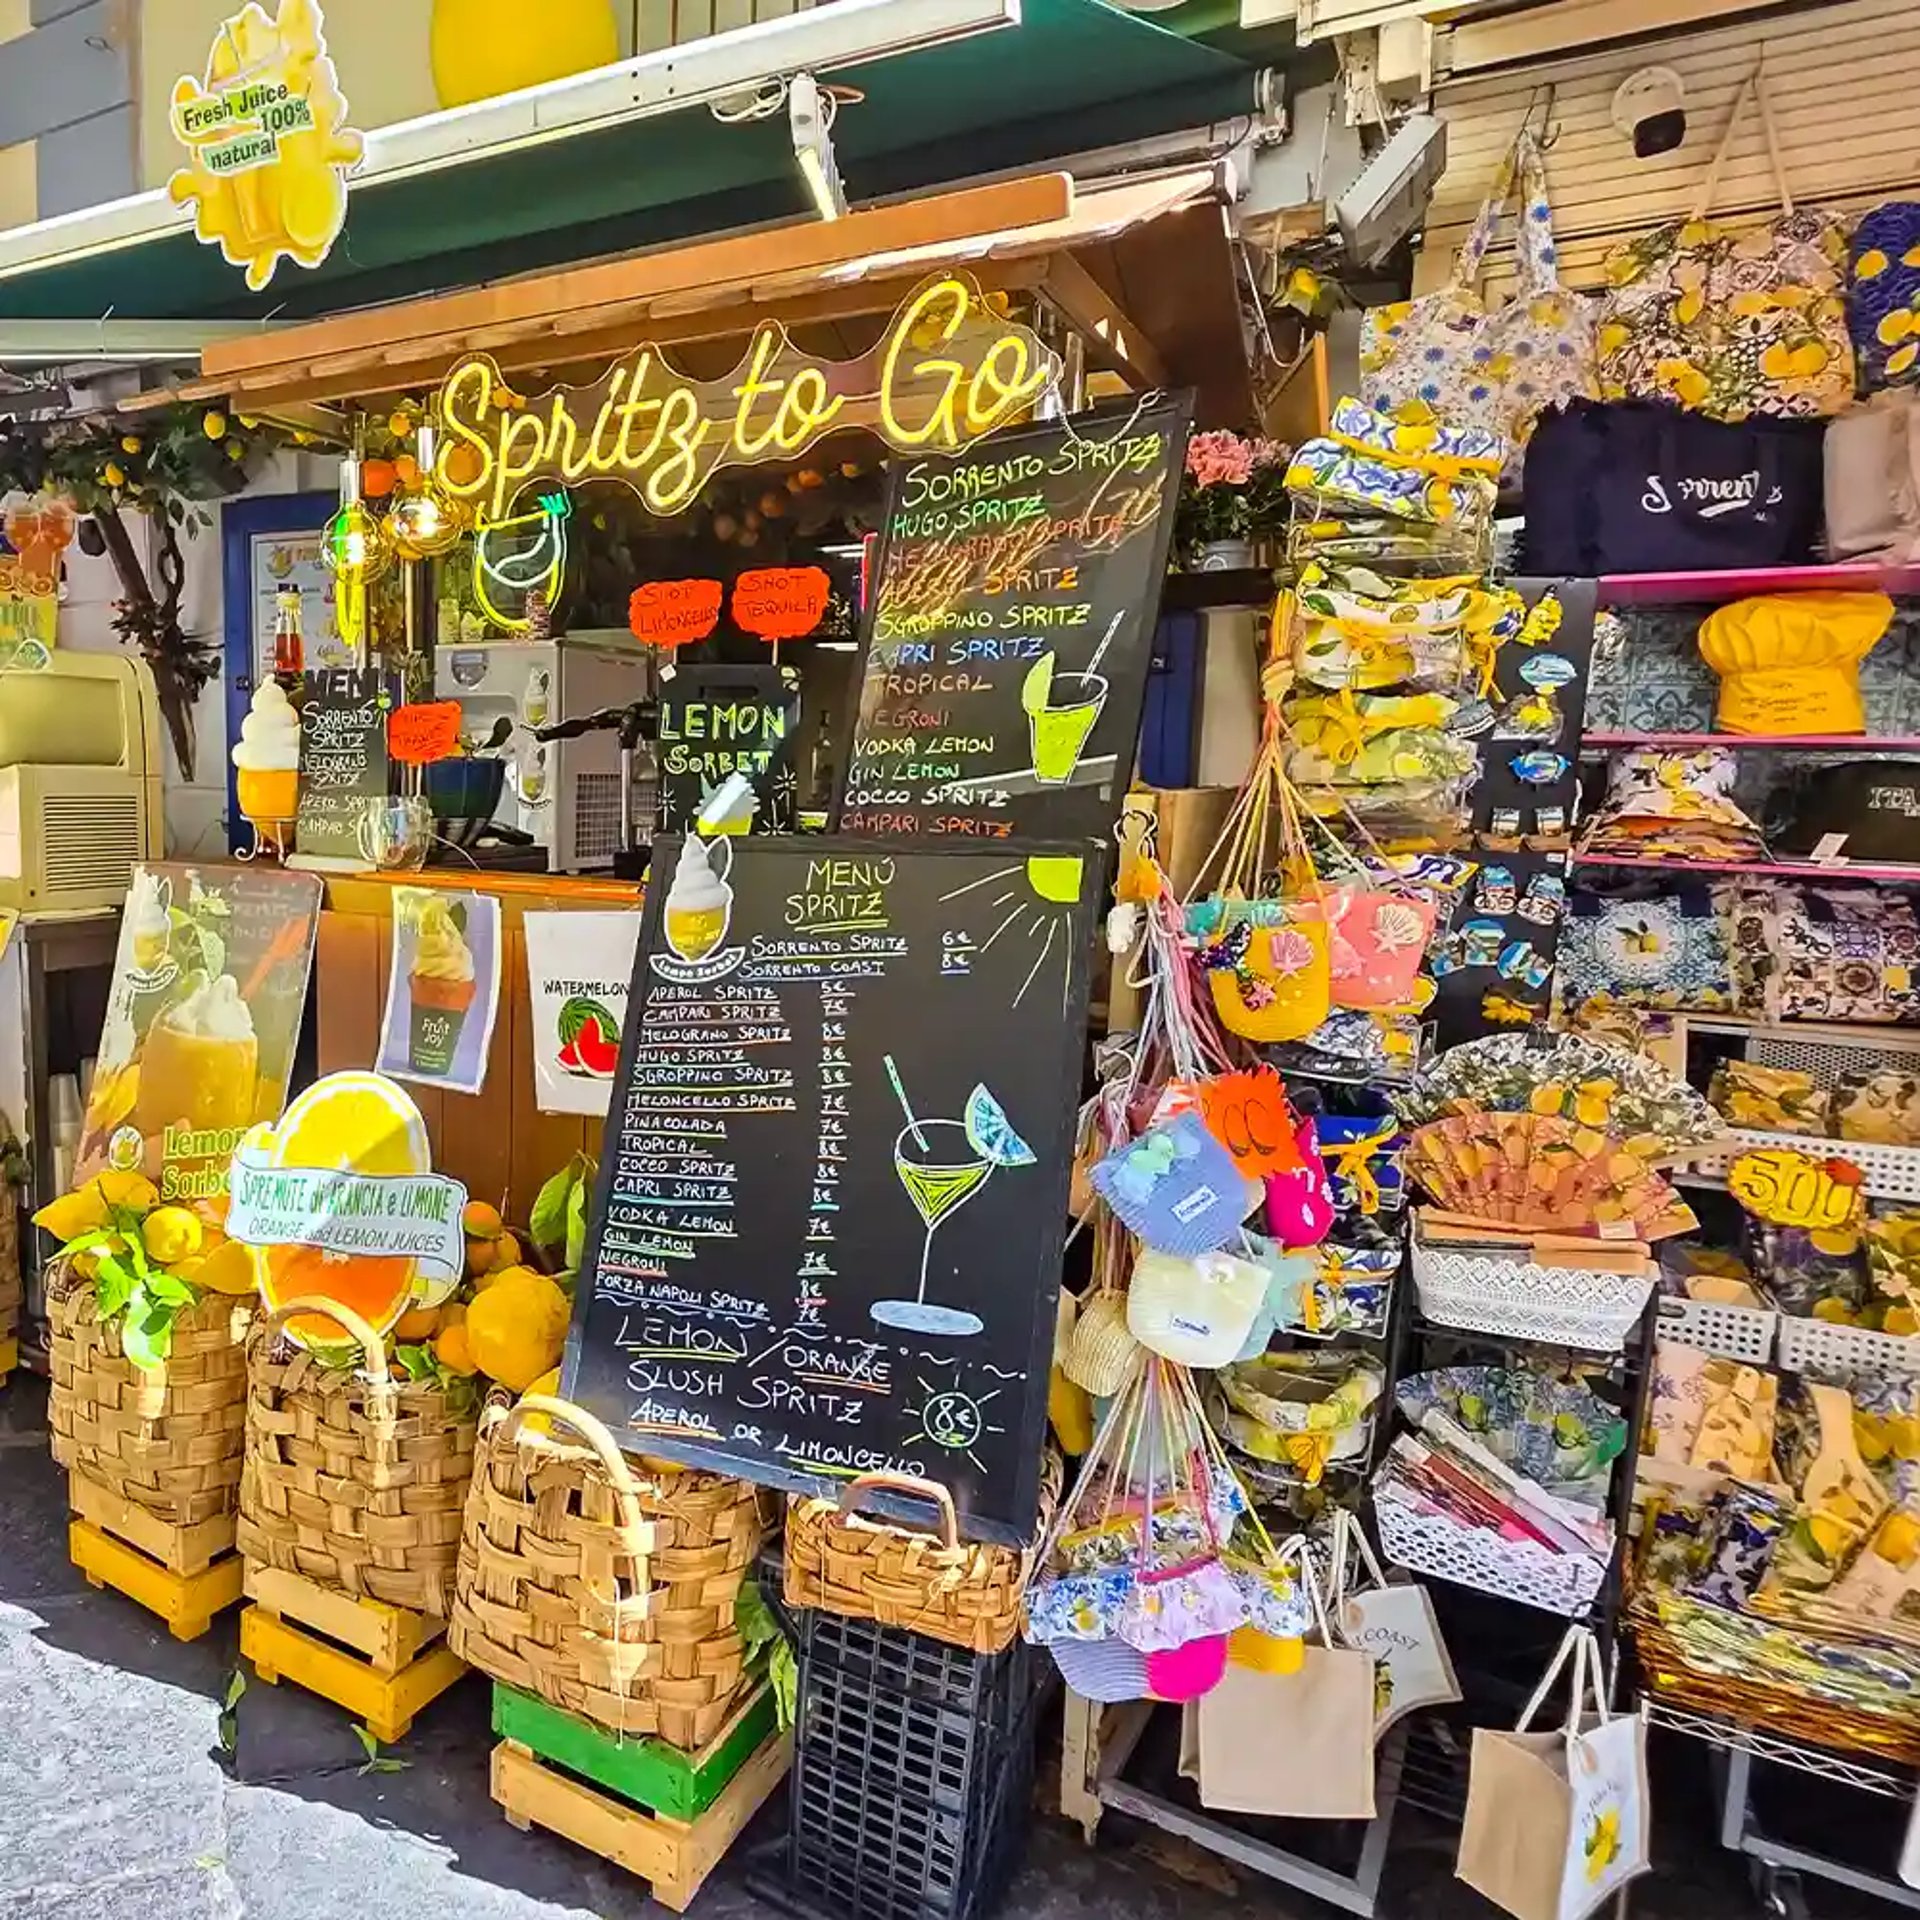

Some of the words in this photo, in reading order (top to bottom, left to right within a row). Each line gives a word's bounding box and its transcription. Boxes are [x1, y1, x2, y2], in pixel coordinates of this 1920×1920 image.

[183, 98, 233, 131] Fresh
[239, 84, 288, 114] Juice
[260, 101, 310, 132] 100%
[210, 133, 278, 169] natural
[437, 351, 709, 521] Spritz
[731, 329, 843, 454] to
[880, 280, 1052, 447] Go
[901, 454, 1044, 508] SORRENTO
[1048, 432, 1161, 476] SPRITZ
[891, 511, 949, 542] HUGO
[953, 494, 1047, 531] SPRITZ
[739, 575, 807, 593] SHOT
[984, 566, 1080, 595] SPRITZ
[738, 593, 818, 618] TEQUILA
[876, 611, 994, 641] SGROPPINO
[999, 604, 1092, 629] SPRITZ
[867, 643, 936, 671] CAPRI
[946, 636, 1046, 665] SPRITZ
[867, 673, 994, 695] TROPICAL
[659, 701, 786, 741] LEMON
[663, 744, 774, 779] SORBET
[853, 736, 917, 758] VODKA
[924, 736, 995, 755] LEMON
[848, 761, 885, 787] GIN
[891, 762, 960, 782] LEMON
[843, 787, 911, 807] COCCO
[921, 785, 1012, 808] SPRITZ
[1867, 786, 1920, 810] ITA
[839, 812, 920, 833] CAMPARI
[929, 815, 1014, 838] SPRITZ
[785, 893, 885, 924] SPRITZ
[751, 934, 842, 957] SORRENTO
[849, 934, 909, 951] SPRITZ
[738, 960, 821, 978] SORRENTO
[830, 960, 886, 975] COAST
[543, 979, 629, 997] WATERMELON
[647, 985, 702, 1002] APEROL
[714, 985, 778, 1000] SPRITZ
[820, 980, 847, 993] 5€
[643, 1005, 712, 1022] CAMPARI
[721, 1005, 781, 1020] SPRITZ
[640, 1027, 729, 1043] MELOGRANO
[738, 1026, 792, 1041] SPRITZ
[822, 1022, 846, 1038] 8€
[637, 1050, 681, 1065] HUGO
[686, 1049, 746, 1063] SPRITZ
[822, 1046, 846, 1061] 8€
[632, 1069, 723, 1086] SGROPPINO
[734, 1068, 794, 1084] SPRITZ
[822, 1069, 846, 1083] 8€
[627, 1093, 731, 1109] MELONCELLO
[736, 1093, 797, 1108] SPRITZ
[822, 1094, 846, 1110] 7€
[821, 1118, 844, 1133] 7€
[621, 1133, 708, 1154] TROPICAL
[818, 1140, 841, 1155] 8€
[161, 1160, 232, 1200] Sorb
[618, 1157, 669, 1173] COCCO
[678, 1160, 737, 1177] SPRITZ
[817, 1163, 839, 1178] 8€
[240, 1172, 308, 1213] SPREMUTE
[387, 1193, 396, 1215] e
[400, 1182, 452, 1225] LIMONE
[613, 1177, 661, 1197] CAPRI
[673, 1183, 733, 1200] SPRITZ
[813, 1188, 833, 1203] 8€
[249, 1216, 304, 1238] ORANGE
[333, 1226, 388, 1248] LEMON
[389, 1231, 446, 1252] JUICES
[607, 1206, 669, 1226] VODKA
[679, 1214, 735, 1233] LEMON
[808, 1217, 833, 1235] 7€
[603, 1227, 631, 1243] GIN
[640, 1234, 694, 1252] LEMON
[803, 1251, 828, 1267] 7€
[599, 1250, 668, 1270] NEGRONI
[800, 1279, 823, 1297] 8€
[595, 1272, 645, 1294] FORZA
[650, 1278, 702, 1303] NAPOLI
[710, 1291, 769, 1313] SPRITZ
[613, 1314, 748, 1357] LEMON
[783, 1345, 892, 1384] ORANGE
[626, 1360, 723, 1396] SLUSH
[737, 1376, 864, 1425] SPRITZ
[629, 1396, 718, 1432] APEROL
[734, 1423, 762, 1443] OR
[774, 1433, 926, 1478] LIMONCELLO
